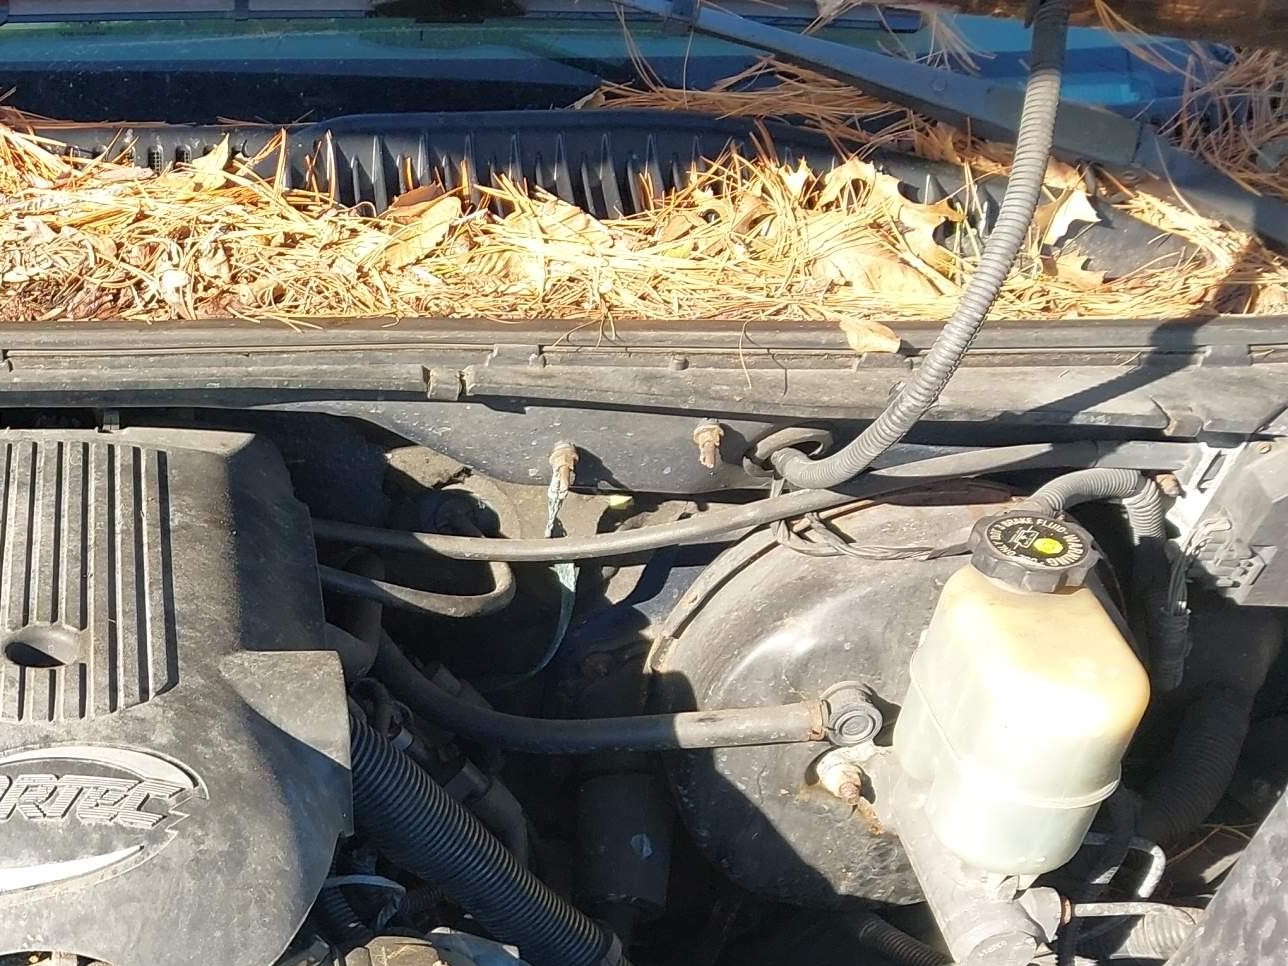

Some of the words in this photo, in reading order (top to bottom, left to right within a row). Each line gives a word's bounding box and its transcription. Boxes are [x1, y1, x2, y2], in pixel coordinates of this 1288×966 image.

[1001, 517, 1034, 527] BRAKE
[1036, 519, 1067, 532] FLUID
[1047, 534, 1083, 567] WARNING
